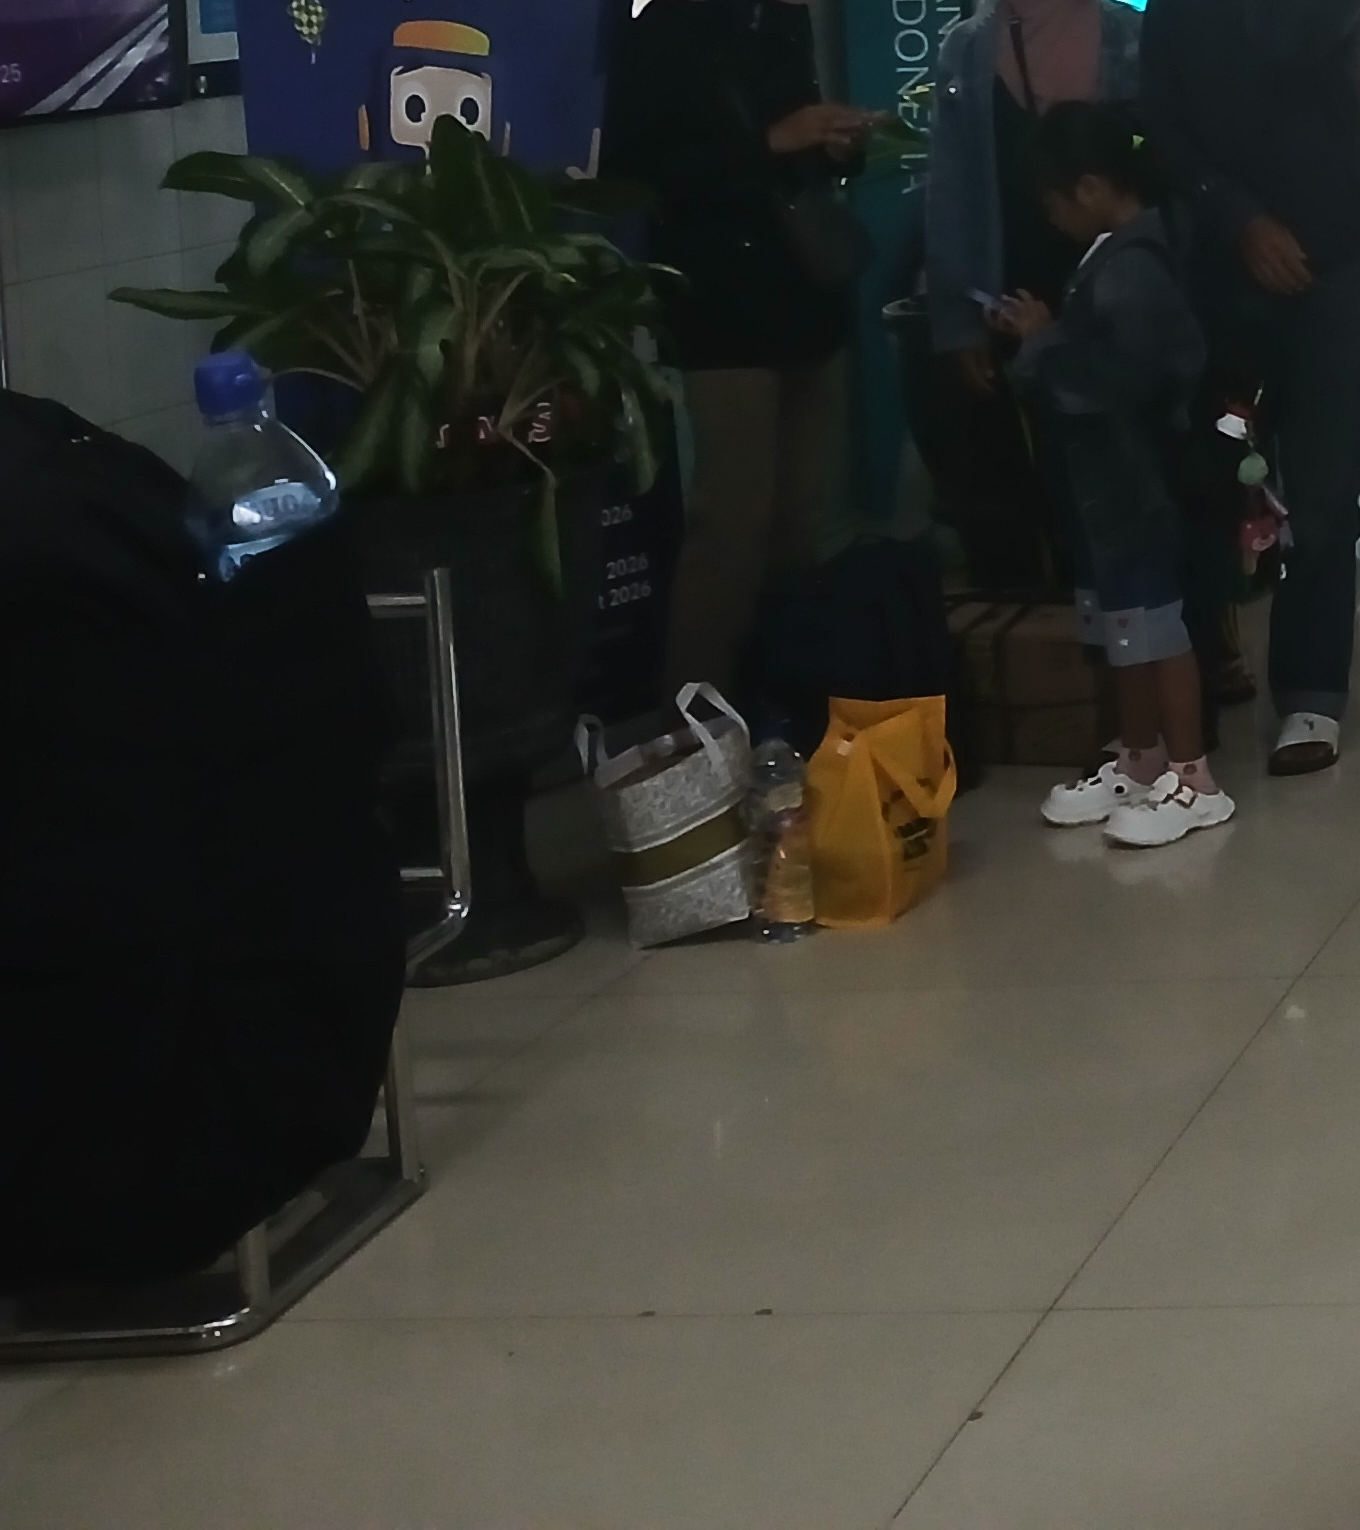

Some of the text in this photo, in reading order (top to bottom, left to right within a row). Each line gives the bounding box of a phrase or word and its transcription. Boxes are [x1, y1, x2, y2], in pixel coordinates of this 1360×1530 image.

[0, 62, 22, 84] 25
[600, 504, 633, 527] 026
[606, 552, 649, 580] 2026
[609, 580, 652, 607] 2026
